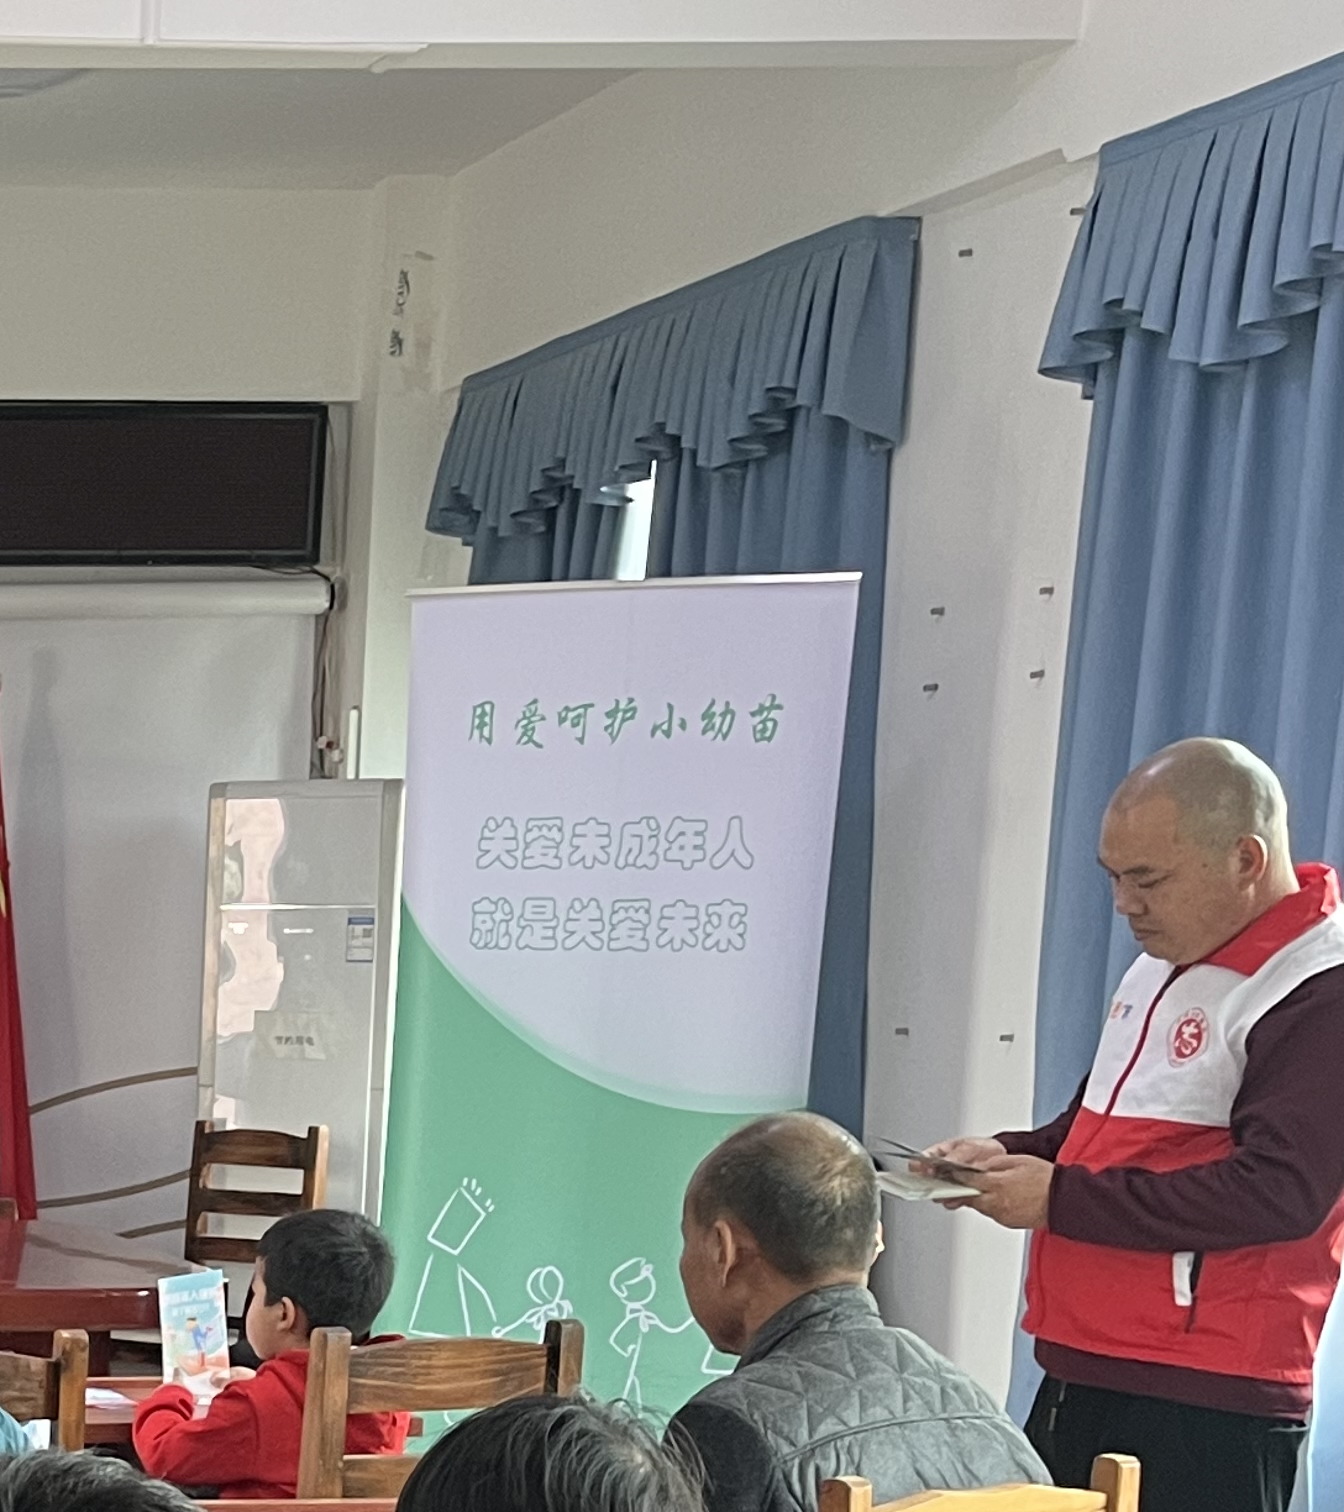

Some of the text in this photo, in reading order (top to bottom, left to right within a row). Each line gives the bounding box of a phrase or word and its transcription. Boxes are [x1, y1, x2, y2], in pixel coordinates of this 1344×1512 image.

[467, 693, 785, 748] 用爱呵护小幼苗
[475, 816, 754, 872] 关爱未成年人
[468, 895, 749, 952] 就是关爱未来
